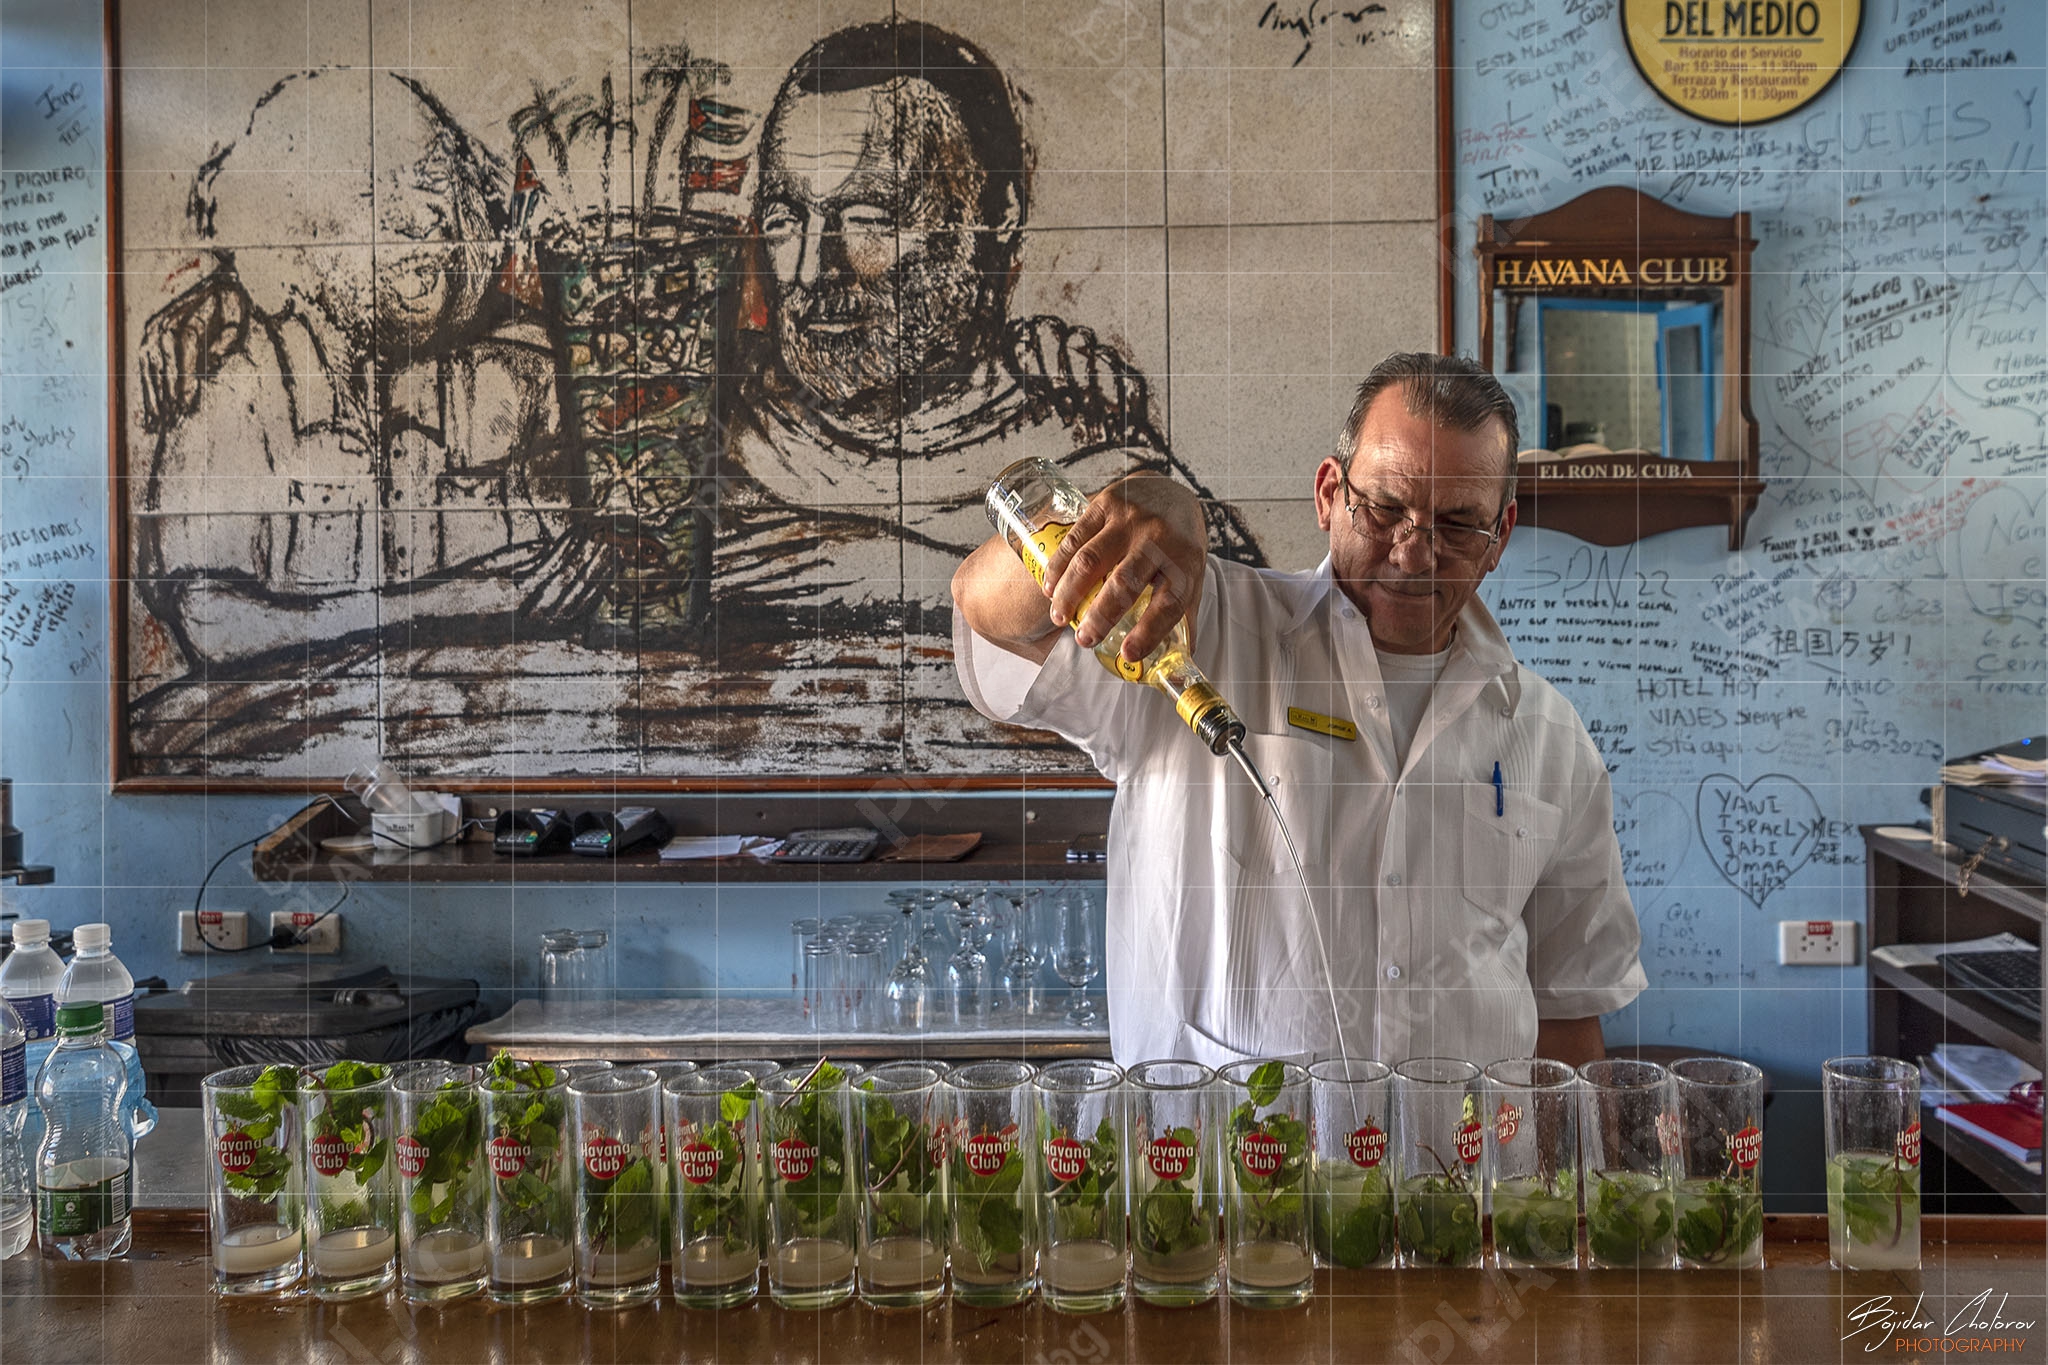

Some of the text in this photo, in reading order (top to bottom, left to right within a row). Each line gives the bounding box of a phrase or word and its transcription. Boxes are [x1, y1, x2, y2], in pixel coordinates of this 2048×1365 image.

[1665, 1, 1819, 36] DEL MEDIO
[1678, 46, 1802, 58] Horario de Servicio
[1664, 60, 1690, 72] Bar:
[1694, 60, 1748, 72] 10:30am
[1761, 60, 1817, 75] 11:30pm
[1672, 74, 1809, 90] Terraza y Restaurante
[1682, 87, 1729, 99] 12:00m
[1742, 87, 1798, 102] 11:30pm
[1477, 164, 1541, 188] Tim
[1496, 257, 1728, 285] HAVANA CLUB
[1540, 464, 1693, 479] EL RON DE CUBA
[1636, 677, 1714, 702] HOTEL
[1648, 707, 1728, 729] VIAJES
[213, 1136, 262, 1151] Havana
[307, 1138, 355, 1155] Havana
[485, 1139, 531, 1156] Havana
[961, 1138, 1011, 1154] Havana
[1237, 1135, 1288, 1155] Havana
[1344, 1132, 1388, 1148] Havana
[581, 1142, 631, 1158] Havana
[675, 1147, 724, 1163] Havana
[770, 1143, 819, 1158] Havana
[1043, 1139, 1091, 1159] Havana
[1144, 1140, 1194, 1158] Havana
[1353, 1148, 1381, 1163] Club
[1737, 1147, 1759, 1163] Club
[220, 1151, 251, 1167] Club
[314, 1154, 344, 1170] Club
[398, 1155, 420, 1172] Club
[491, 1156, 520, 1173] Club
[589, 1157, 621, 1173] Club
[778, 1158, 809, 1175] Club
[969, 1154, 1001, 1170] Club
[1050, 1159, 1080, 1175] Club
[1152, 1157, 1183, 1174] Club
[1245, 1154, 1276, 1170] Club
[683, 1163, 714, 1179] Club
